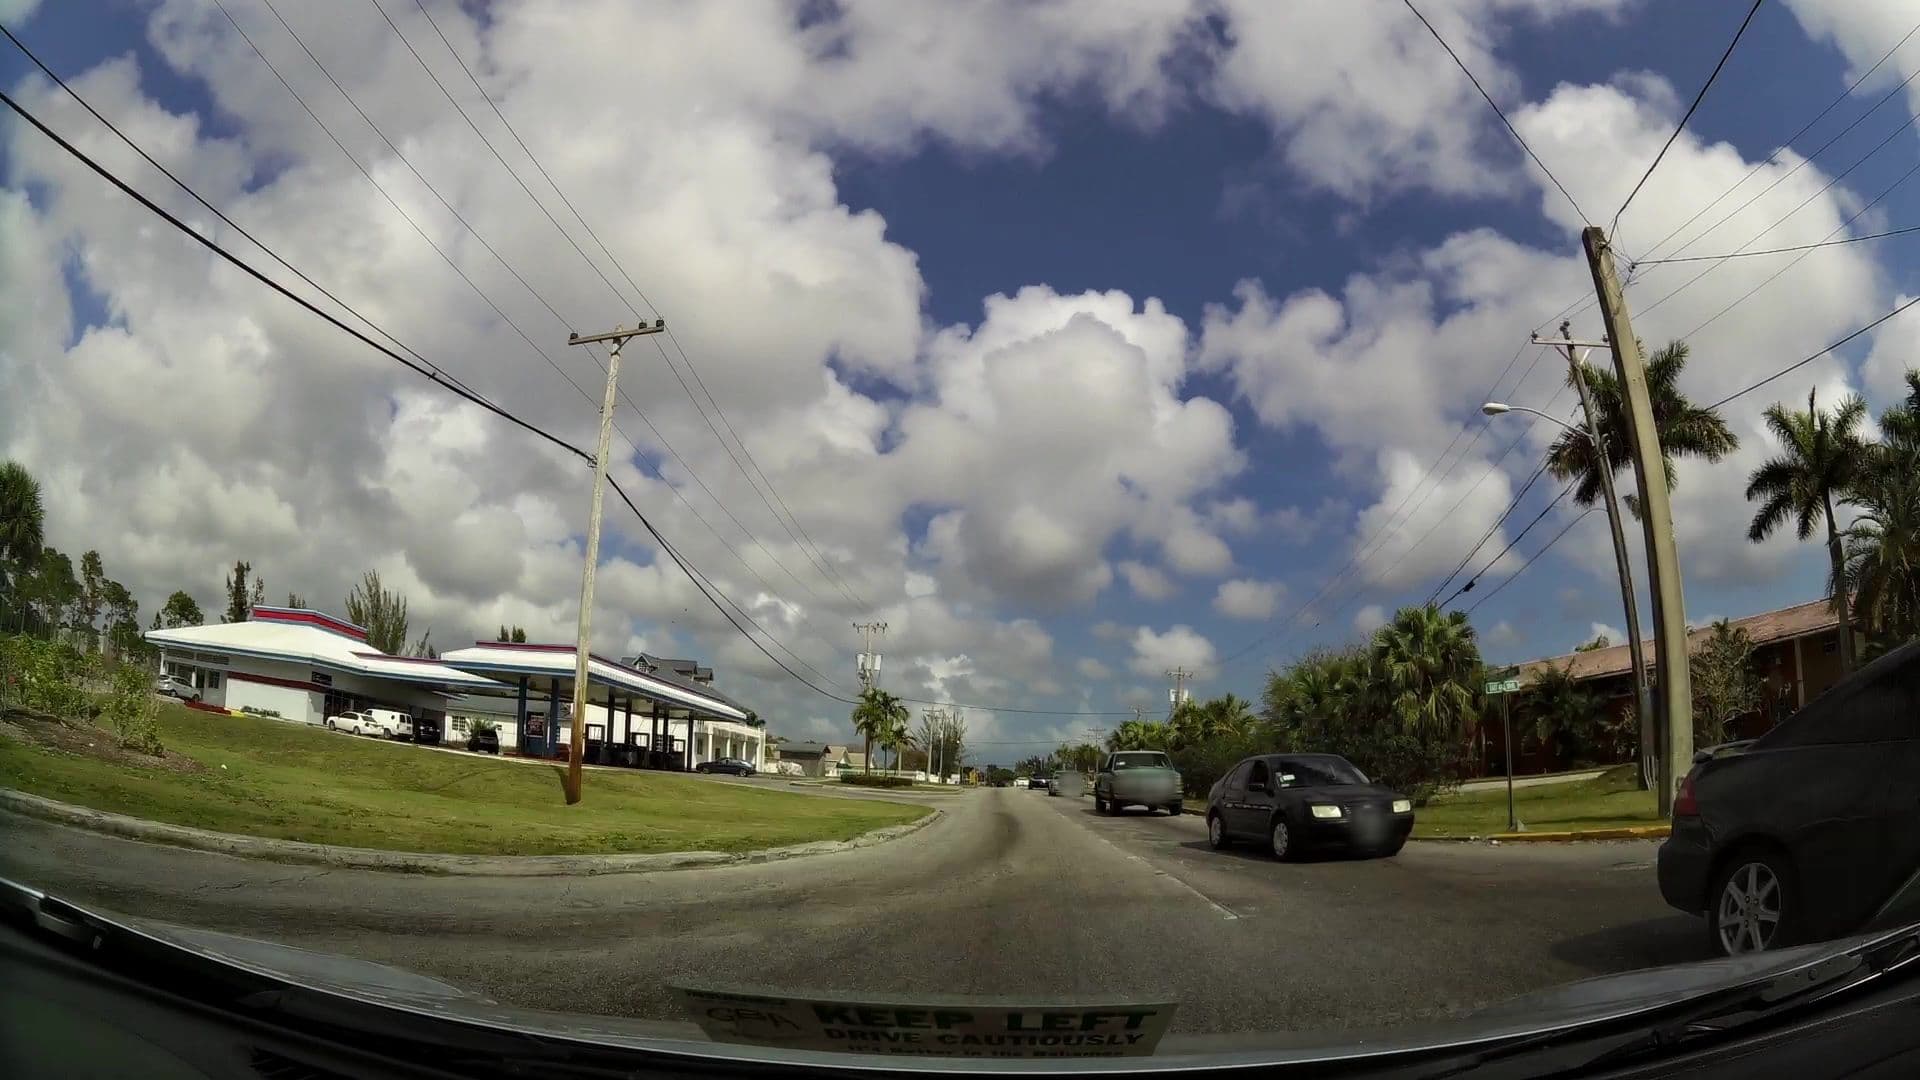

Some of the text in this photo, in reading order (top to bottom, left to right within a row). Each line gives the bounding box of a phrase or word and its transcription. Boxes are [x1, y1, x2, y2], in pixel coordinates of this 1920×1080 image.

[812, 1005, 1157, 1031] KEEP LEFT
[824, 1028, 1144, 1046] DRIVE CAUTIOUSLY
